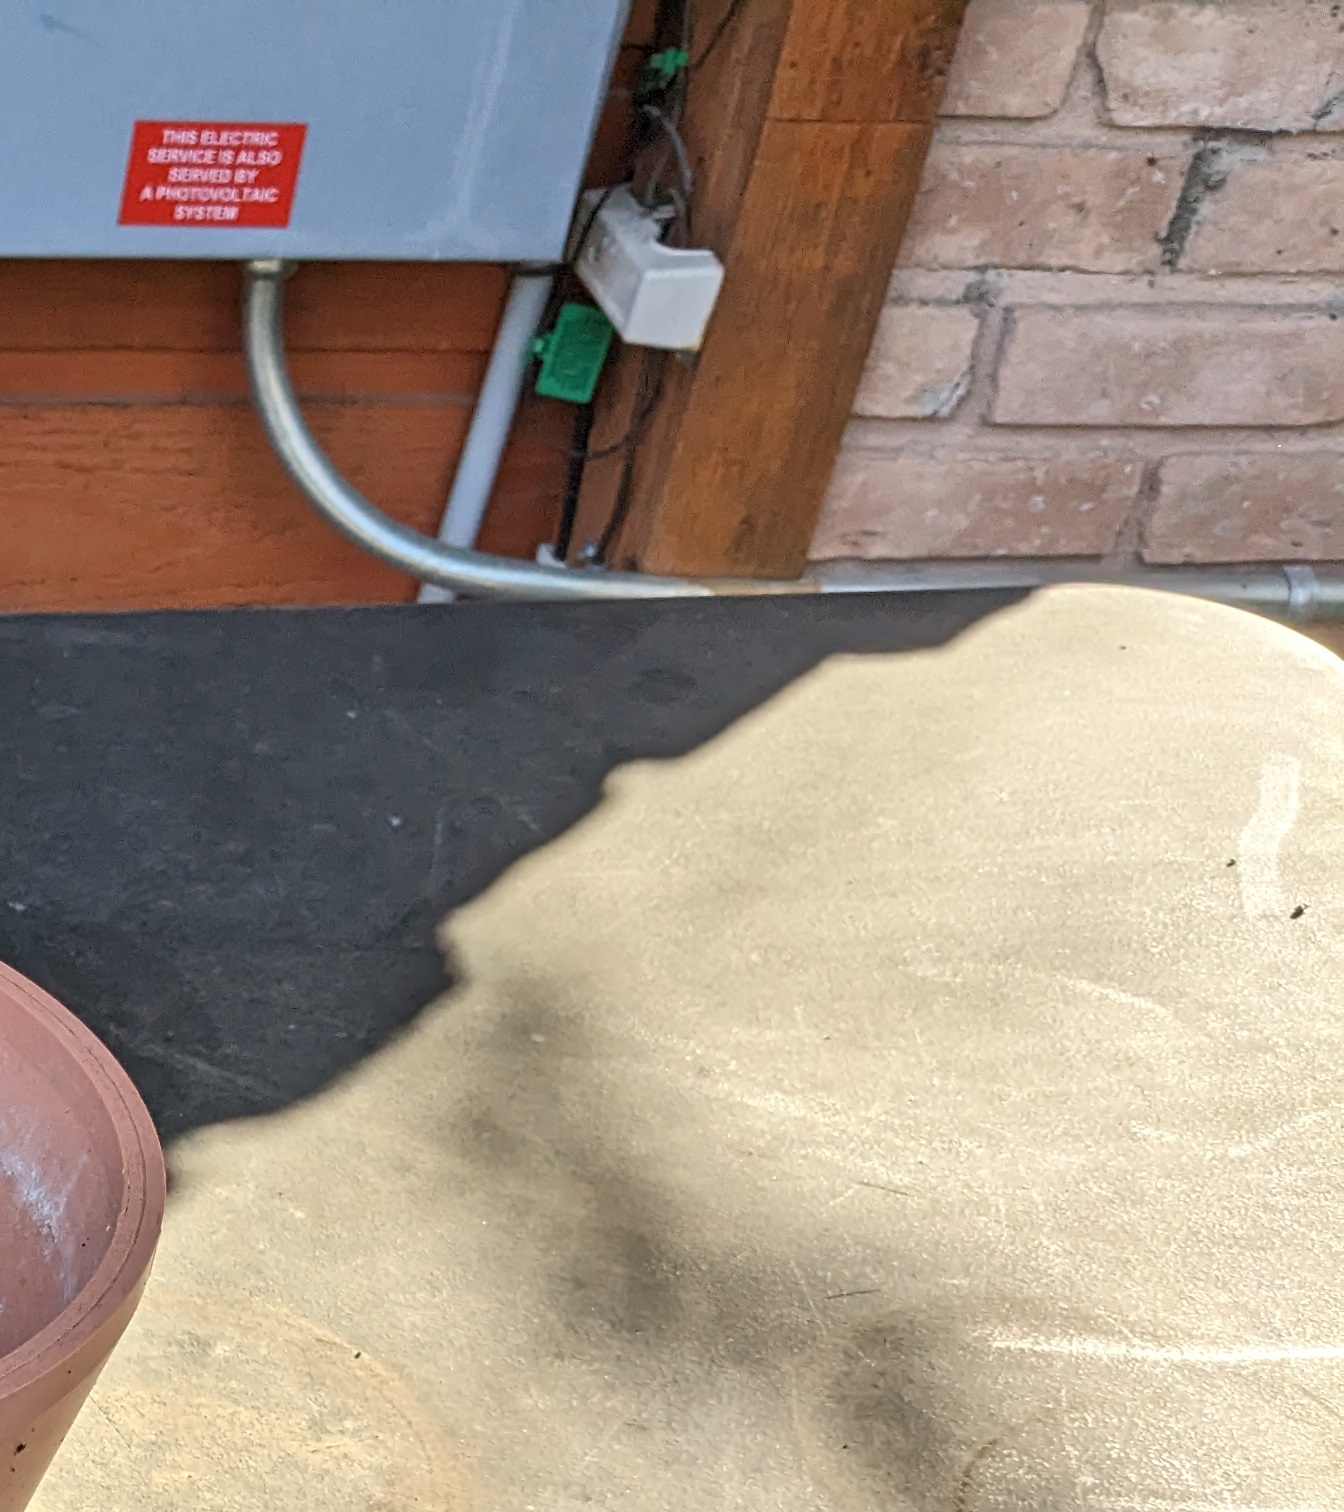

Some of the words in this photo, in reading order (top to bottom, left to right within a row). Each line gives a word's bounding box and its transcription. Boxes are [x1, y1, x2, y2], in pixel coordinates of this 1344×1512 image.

[163, 130, 198, 145] THIS
[200, 130, 279, 146] ELECTRIC
[147, 148, 217, 164] SERVICE
[218, 149, 235, 164] IS
[236, 150, 282, 166] ALSO
[168, 167, 233, 183] SERVED
[234, 168, 260, 183] BY
[139, 185, 154, 201] A
[155, 186, 279, 202] PHOTOVOLTAIC
[174, 205, 239, 220] SYSTEM
